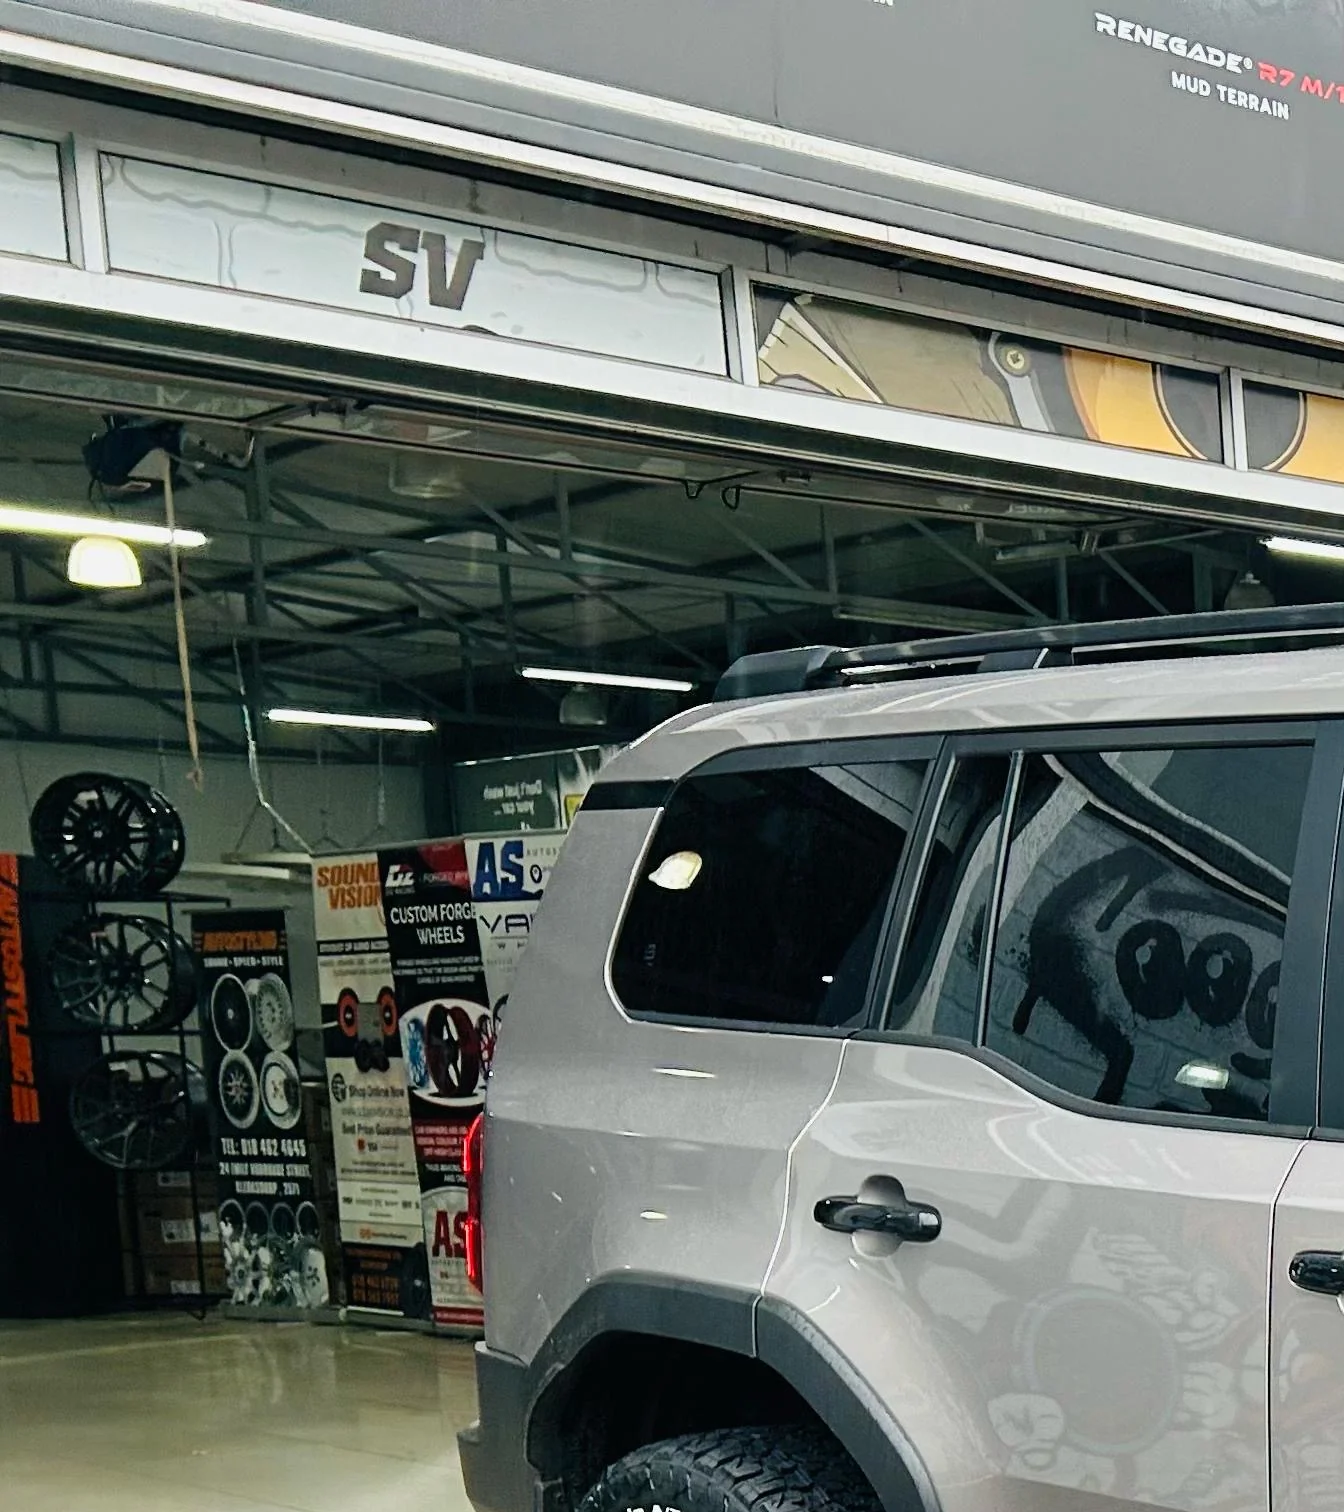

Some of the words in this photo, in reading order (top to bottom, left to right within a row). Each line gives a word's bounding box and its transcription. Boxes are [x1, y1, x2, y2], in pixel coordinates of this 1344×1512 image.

[1257, 61, 1295, 86] R7
[1171, 71, 1211, 97] MUD
[1216, 83, 1290, 120] TERRAIN
[360, 221, 485, 311] SV
[472, 840, 525, 899] AS
[390, 905, 438, 924] CUSTOM
[480, 913, 533, 934] VA
[416, 925, 465, 945] WHEELS
[432, 1210, 468, 1258] AS
